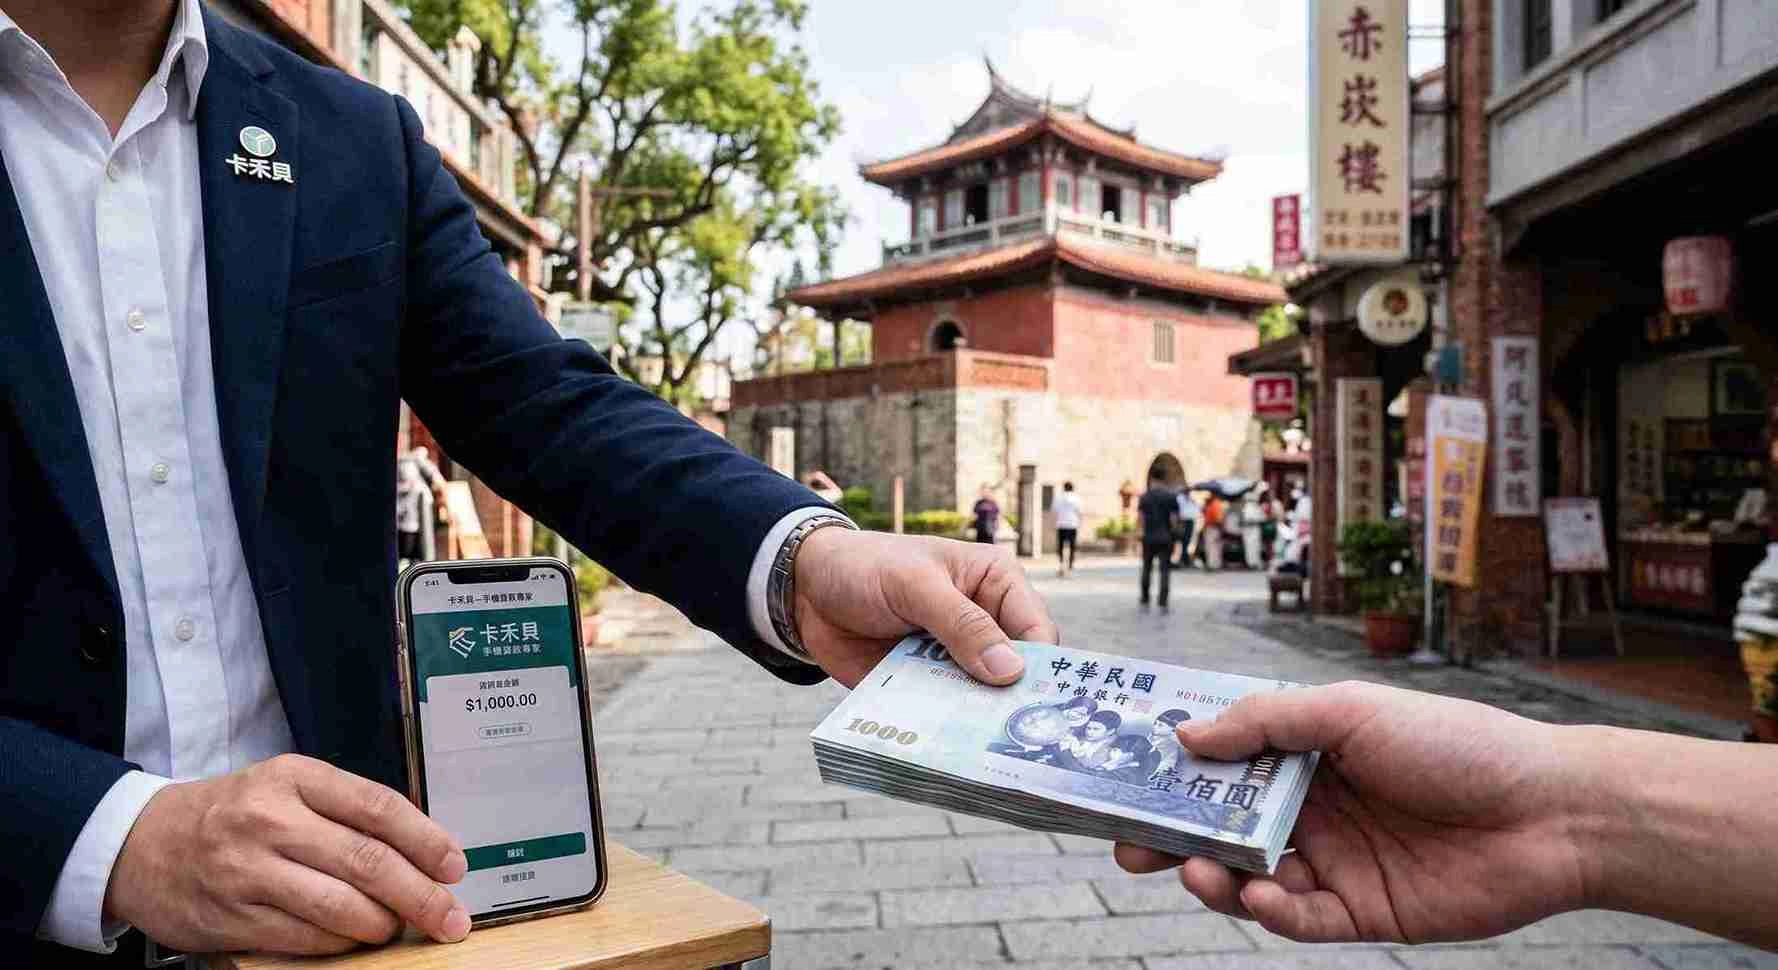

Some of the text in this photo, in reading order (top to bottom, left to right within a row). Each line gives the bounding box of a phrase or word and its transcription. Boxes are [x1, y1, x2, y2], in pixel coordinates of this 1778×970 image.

[1337, 6, 1387, 194] 赤崁樓
[225, 153, 294, 183] 卡禾貝
[480, 621, 540, 645] 卡禾貝
[1051, 657, 1156, 693] 中華民國
[465, 693, 537, 712] $1,000.00
[845, 718, 919, 745] 1000
